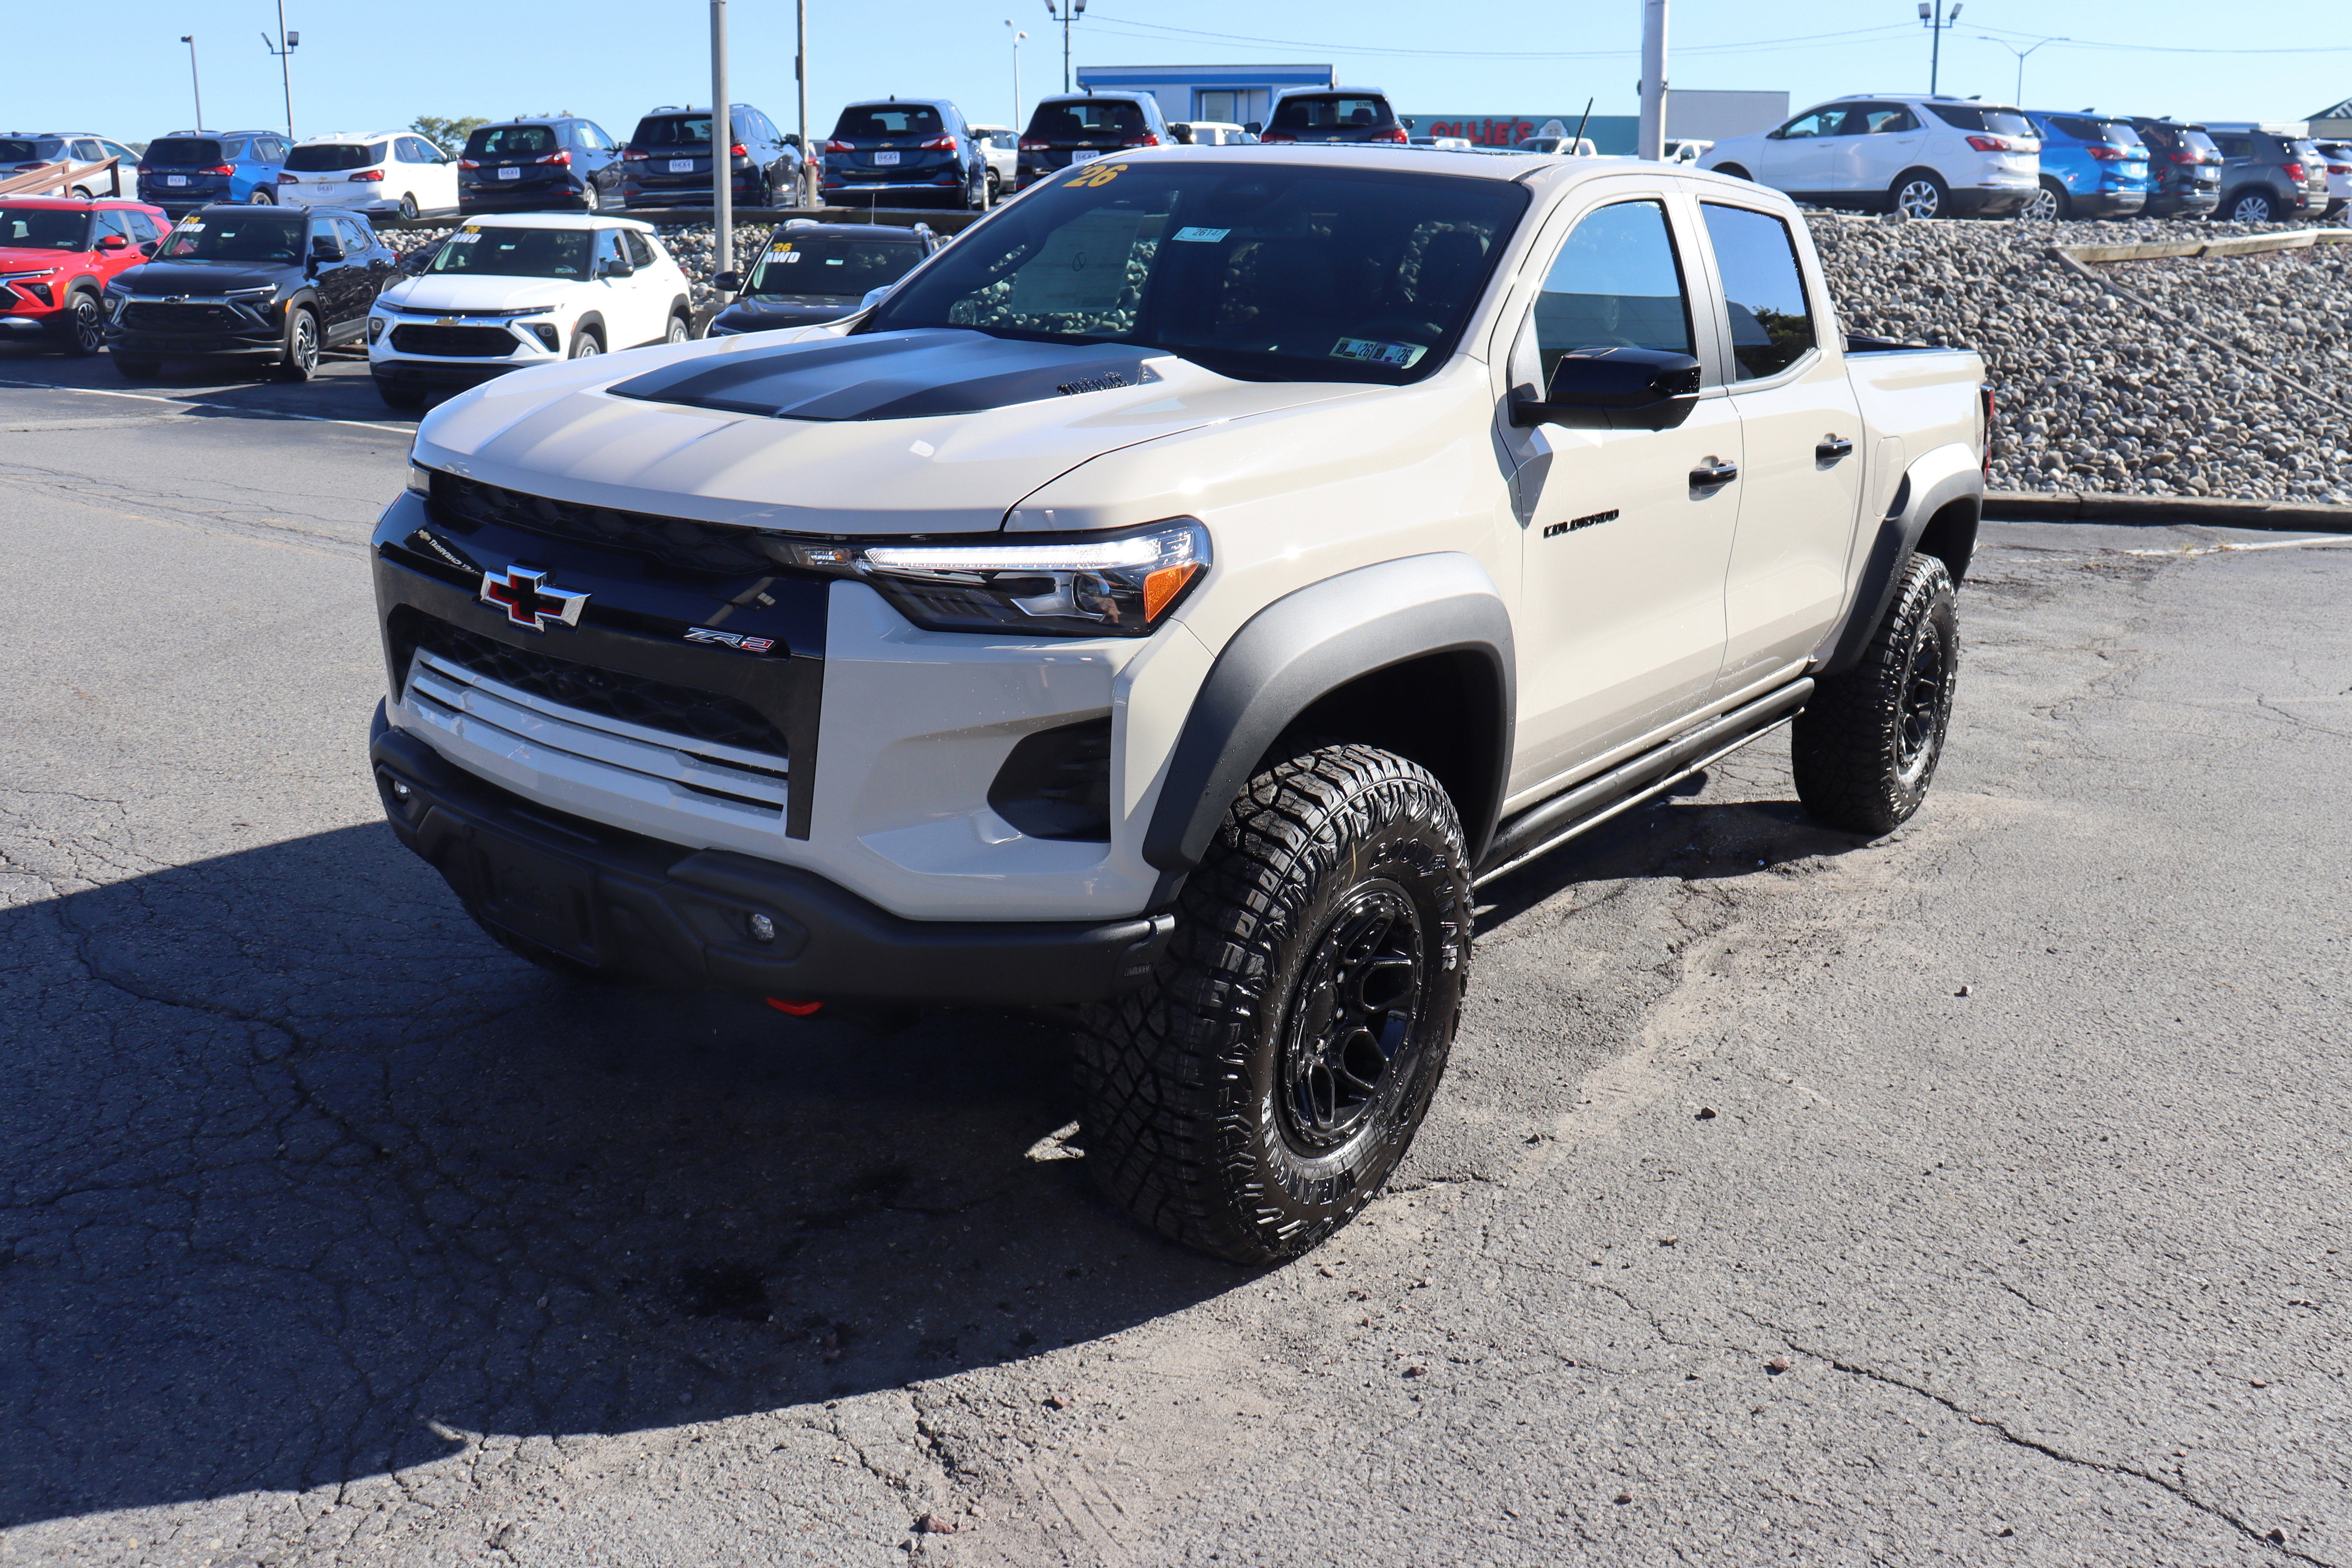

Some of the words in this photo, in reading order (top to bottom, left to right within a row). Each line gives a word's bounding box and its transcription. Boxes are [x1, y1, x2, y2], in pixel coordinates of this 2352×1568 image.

[175, 223, 206, 232] AWD
[449, 233, 482, 243] AWD
[761, 252, 801, 263] AWD
[1336, 343, 1349, 354] 10
[1359, 343, 1374, 356] 26
[1373, 347, 1386, 359] 10
[1397, 350, 1412, 361] 26
[1544, 509, 1619, 539] COLORADO
[683, 627, 775, 653] ZR2
[1369, 837, 1459, 971] GOODYEAR
